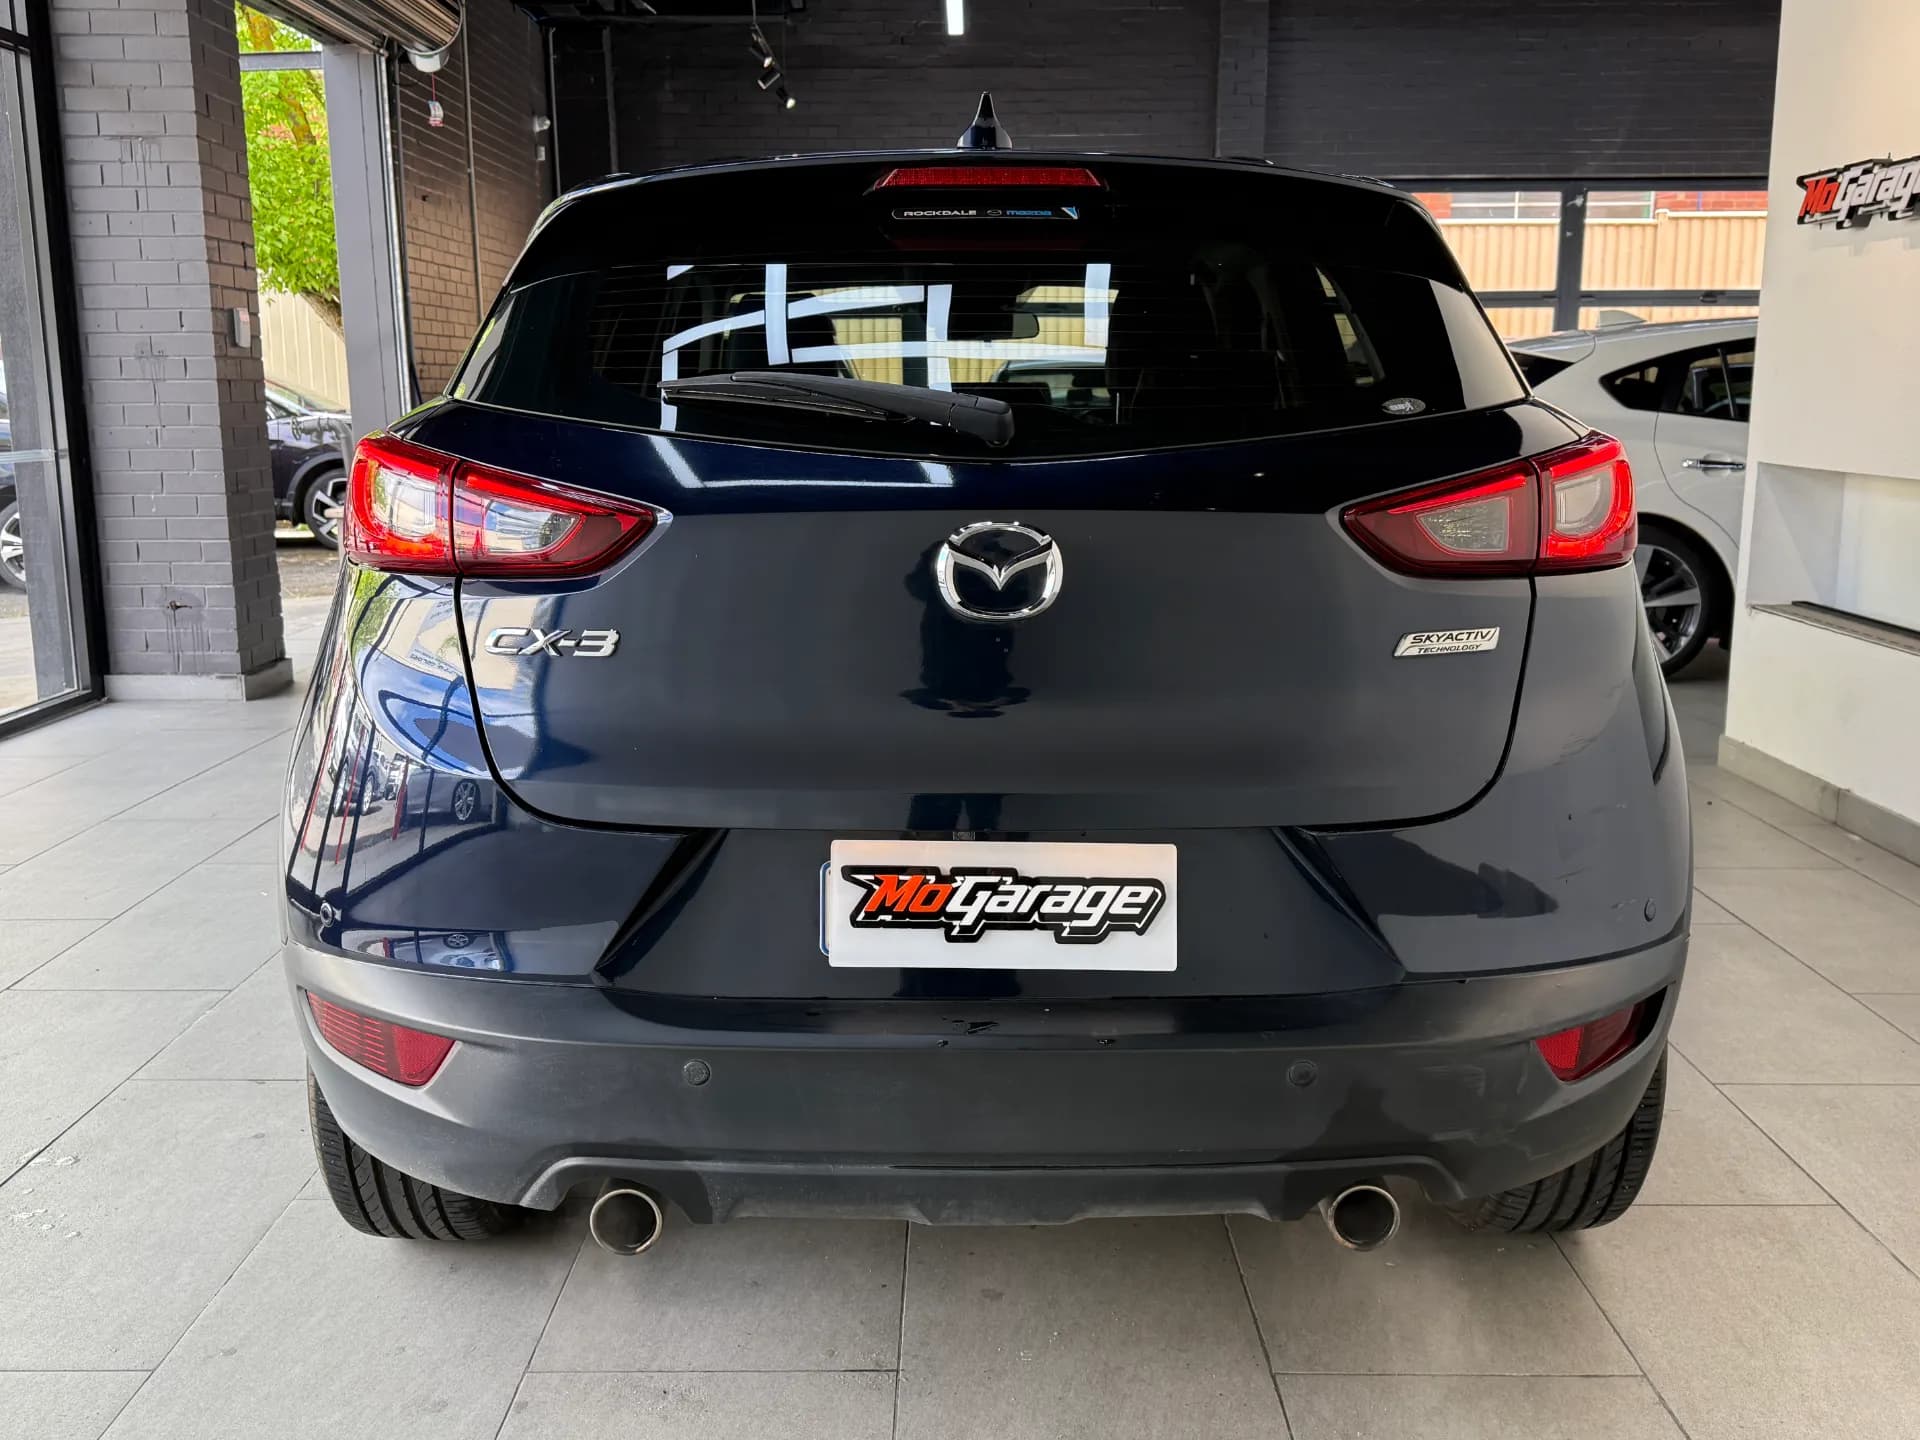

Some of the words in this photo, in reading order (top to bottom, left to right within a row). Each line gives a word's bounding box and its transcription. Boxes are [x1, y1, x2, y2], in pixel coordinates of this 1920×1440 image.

[904, 209, 977, 217] ROCKDALE
[484, 627, 620, 657] CX-3
[1411, 630, 1491, 644] SKYACTIV
[1417, 644, 1482, 653] TECHNOLOGY
[855, 873, 1162, 935] MoGarage
